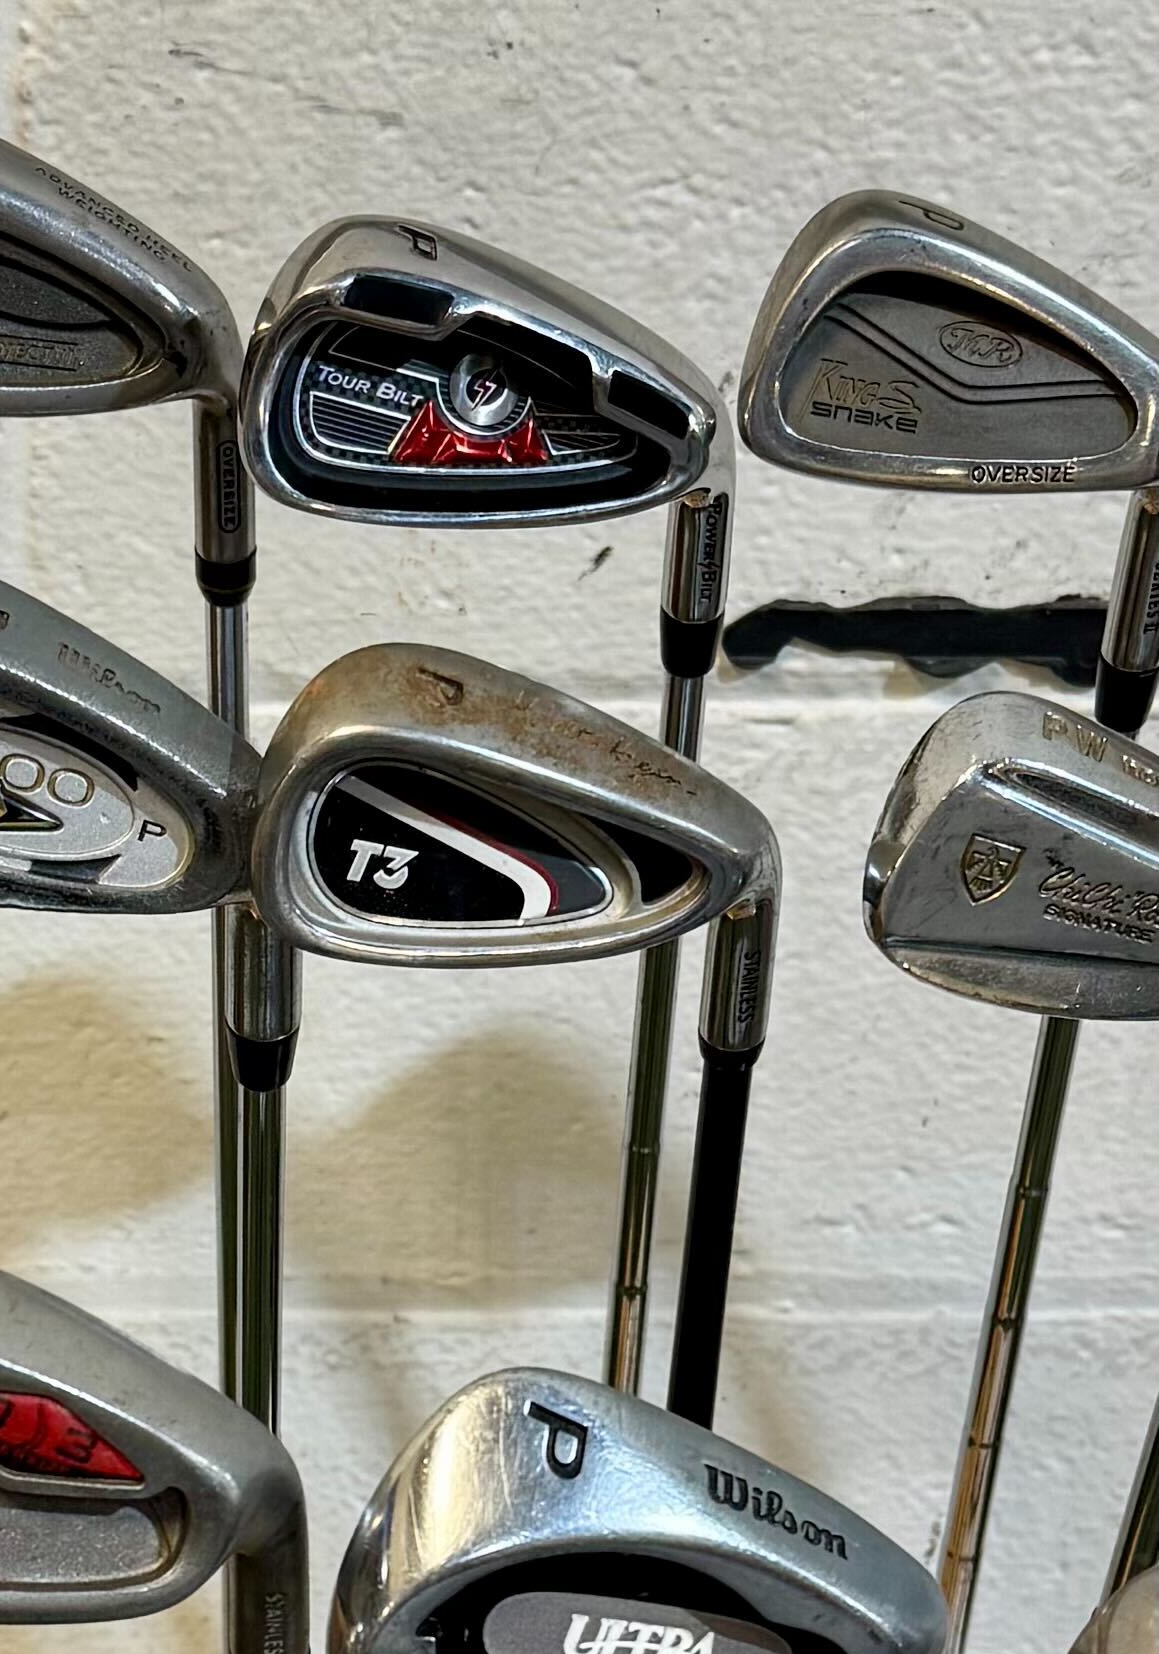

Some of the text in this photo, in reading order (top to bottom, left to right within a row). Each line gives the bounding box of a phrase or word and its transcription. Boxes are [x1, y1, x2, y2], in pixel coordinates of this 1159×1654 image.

[971, 465, 1076, 486] OVERSIZE
[137, 818, 167, 843] P
[345, 838, 420, 889] T3
[738, 951, 761, 1023] STAINLESS
[524, 1400, 588, 1480] P
[704, 1465, 848, 1560] Wilson
